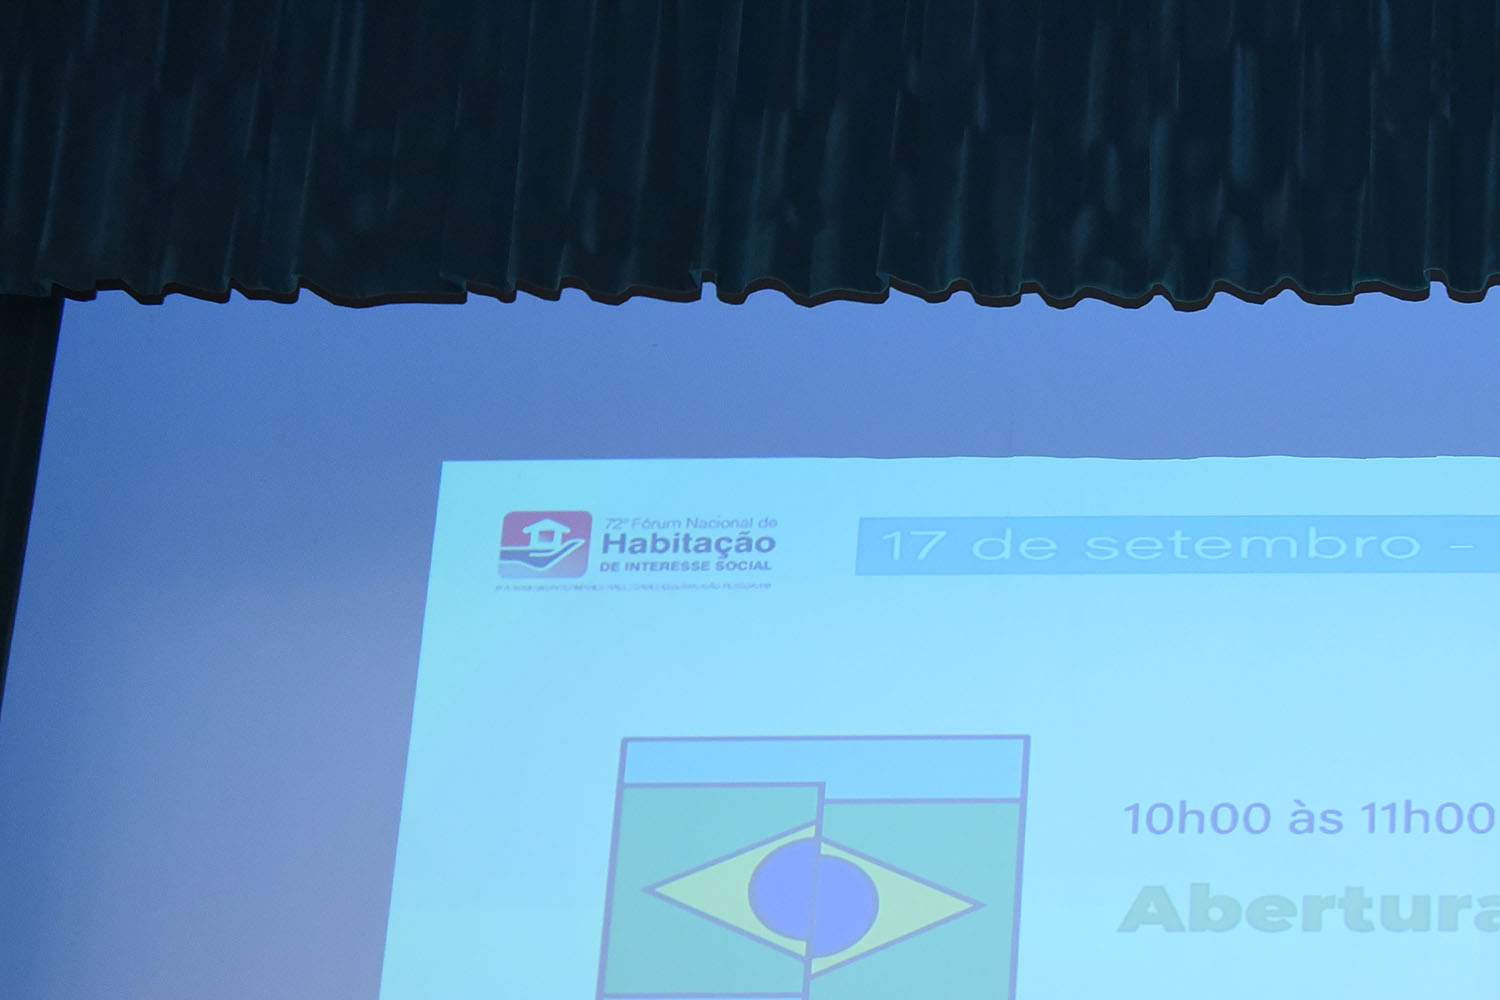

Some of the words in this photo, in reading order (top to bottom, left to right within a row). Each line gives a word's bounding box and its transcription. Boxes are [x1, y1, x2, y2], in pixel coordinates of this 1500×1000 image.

[631, 516, 682, 529] Fórum
[686, 516, 754, 529] Nacional
[758, 517, 778, 529] de
[602, 530, 777, 559] Habitação
[880, 529, 947, 561] 17
[972, 528, 1058, 560] de
[1084, 527, 1421, 560] setembro
[600, 561, 619, 573] DE
[625, 560, 711, 573] INTERESSE
[716, 560, 772, 572] SOCIAL
[1123, 800, 1271, 835] 10h00
[1288, 799, 1344, 835] às
[1361, 800, 1496, 835] 11h00
